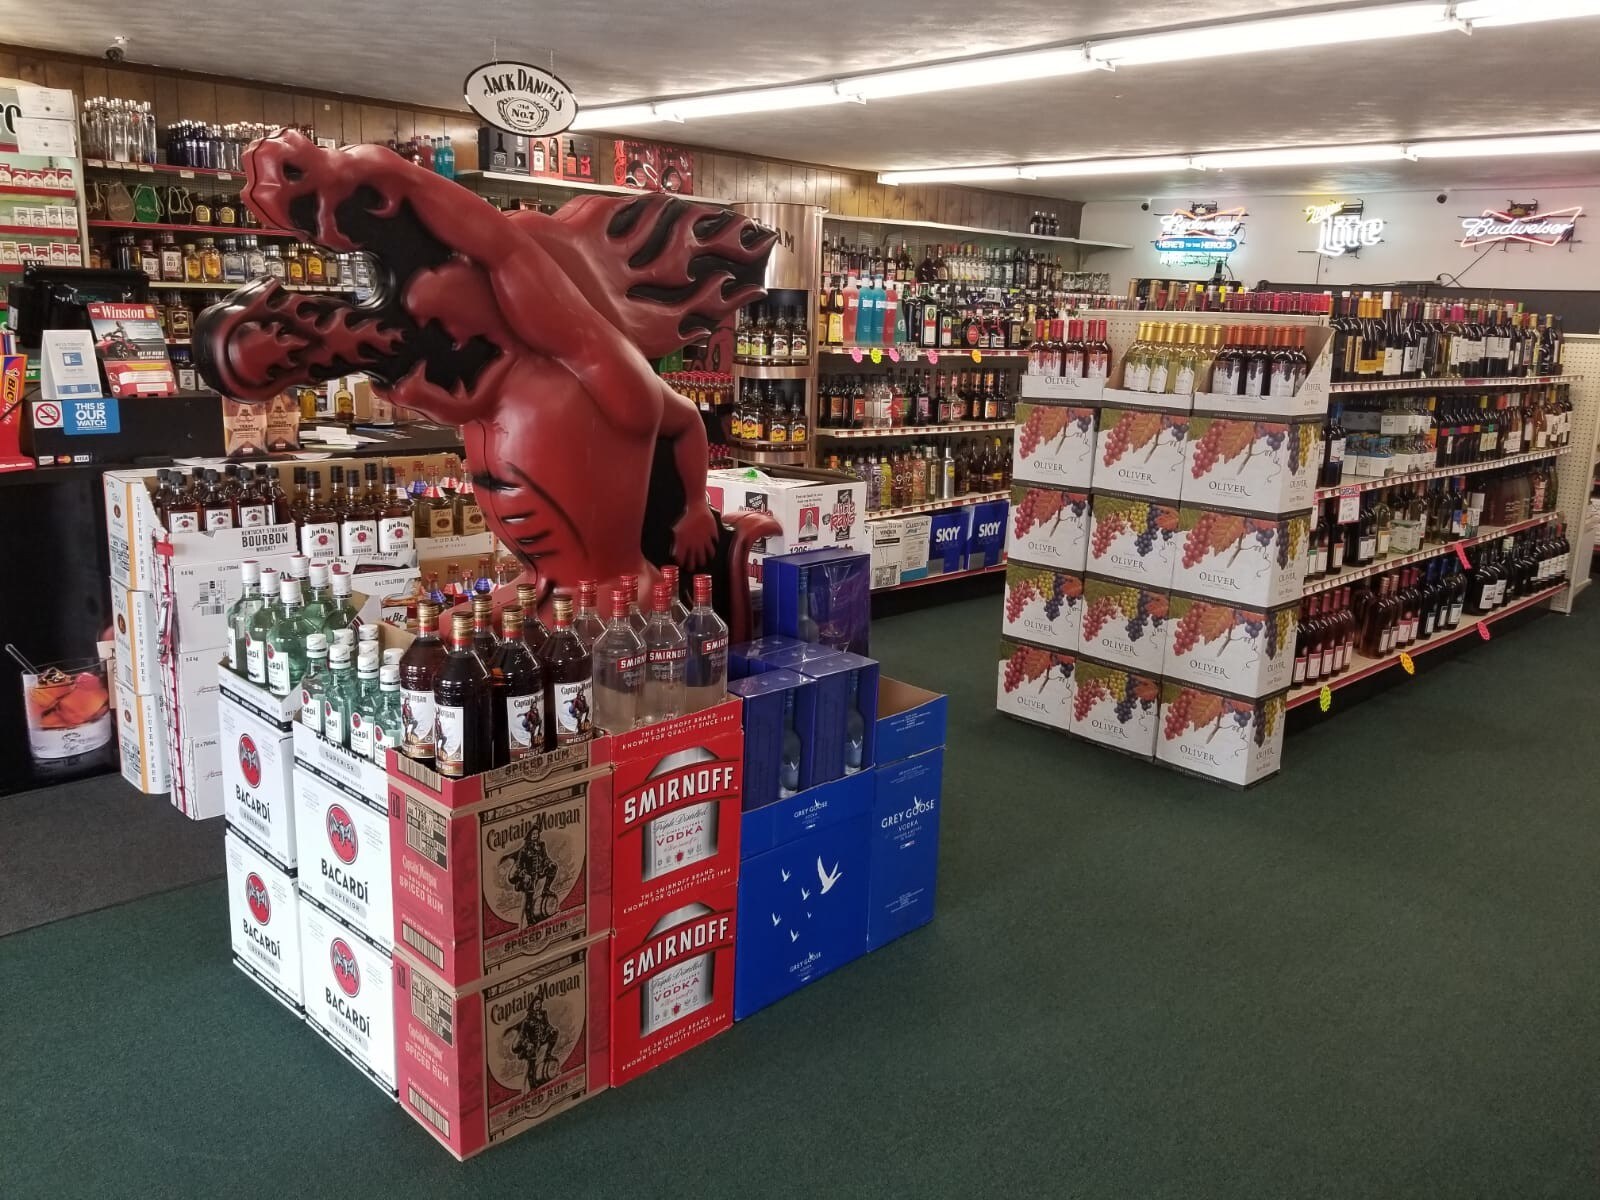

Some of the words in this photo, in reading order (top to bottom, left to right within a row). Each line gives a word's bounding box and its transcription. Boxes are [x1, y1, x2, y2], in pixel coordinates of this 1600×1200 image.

[483, 74, 516, 98] JACK
[518, 68, 565, 112] DANIEL'S
[511, 107, 535, 121] No.7
[1316, 215, 1384, 257] Lite
[1462, 218, 1575, 237] Budweiser
[101, 305, 145, 319] Winston
[6, 377, 17, 401] BIC
[1045, 375, 1080, 388] OLIVER
[75, 403, 95, 411] THIS
[96, 403, 105, 411] IS
[75, 410, 105, 420] OUR
[76, 419, 107, 427] WATCH
[1034, 460, 1067, 474] OLIVER
[1119, 468, 1156, 484] OLIVER
[1208, 481, 1251, 497] OLIVER
[310, 528, 321, 538] JIM
[321, 527, 334, 536] BEAM
[350, 525, 361, 535] JIM
[360, 525, 373, 533] BEAM
[387, 522, 398, 532] JIM
[397, 521, 409, 529] BEAM
[936, 527, 960, 543] SKYY
[978, 521, 1001, 537] SKYY
[242, 533, 288, 547] BOURBON
[1028, 541, 1061, 556] OLIVER
[1111, 555, 1147, 571] OLIVER
[1199, 571, 1240, 589] OLIVER
[393, 612, 408, 622] BEA
[1024, 620, 1056, 635] OLIVER
[650, 649, 687, 661] SMIRNOFF
[1102, 638, 1137, 657] OLIVER
[620, 654, 646, 669] SMIRN
[1189, 659, 1230, 679] OLIVER
[1017, 696, 1049, 714] OLIVER
[622, 738, 649, 750] KNOWN
[652, 734, 665, 742] FOR
[667, 724, 696, 738] QUALITY
[698, 718, 718, 729] SINCE
[641, 730, 654, 738] THE
[656, 719, 692, 735] SMIRNOFF
[694, 712, 717, 723] BRAND
[1091, 719, 1128, 738] OLIVER
[505, 757, 543, 775] SPICED
[547, 749, 570, 760] RUM
[1180, 744, 1219, 765] OLIVER
[235, 784, 272, 823] BACARDÍ
[623, 766, 734, 824] SMIRNOFF
[881, 811, 904, 829] GREY
[905, 799, 935, 819] GOOSE
[486, 822, 532, 852] Captain
[530, 806, 580, 832] Morgan
[898, 819, 919, 832] VODKA
[657, 825, 703, 846] VODKA
[321, 858, 370, 903] BACARDÍ
[641, 891, 654, 900] THE
[656, 877, 690, 897] SMIRNOFF
[692, 868, 714, 881] BRAND
[400, 874, 425, 902] SPICED
[427, 894, 444, 915] RUM
[623, 900, 649, 914] KNOWN
[652, 893, 664, 903] FOR
[666, 881, 694, 898] QUALITY
[697, 872, 715, 885] SINCE
[242, 918, 281, 960] BACARDÍ
[504, 932, 542, 951] SPICED
[545, 921, 568, 936] RUM
[623, 917, 729, 985] SMIRNOFF
[491, 992, 533, 1025] Captain
[531, 973, 580, 1000] Morgan
[654, 977, 700, 1002] VODKA
[325, 986, 371, 1037] BACARDÍ
[639, 1046, 652, 1055] THE
[653, 1027, 686, 1048] SMIRNOFF
[688, 1016, 710, 1030] BRAND
[622, 1056, 647, 1071] KNOWN
[649, 1048, 662, 1058] FOR
[663, 1032, 691, 1050] QUALITY
[692, 1021, 711, 1035] SINCE
[405, 1041, 431, 1071] SPICED
[432, 1063, 449, 1088] RUM
[508, 1098, 543, 1117] SPICED
[547, 1082, 568, 1096] RUM
